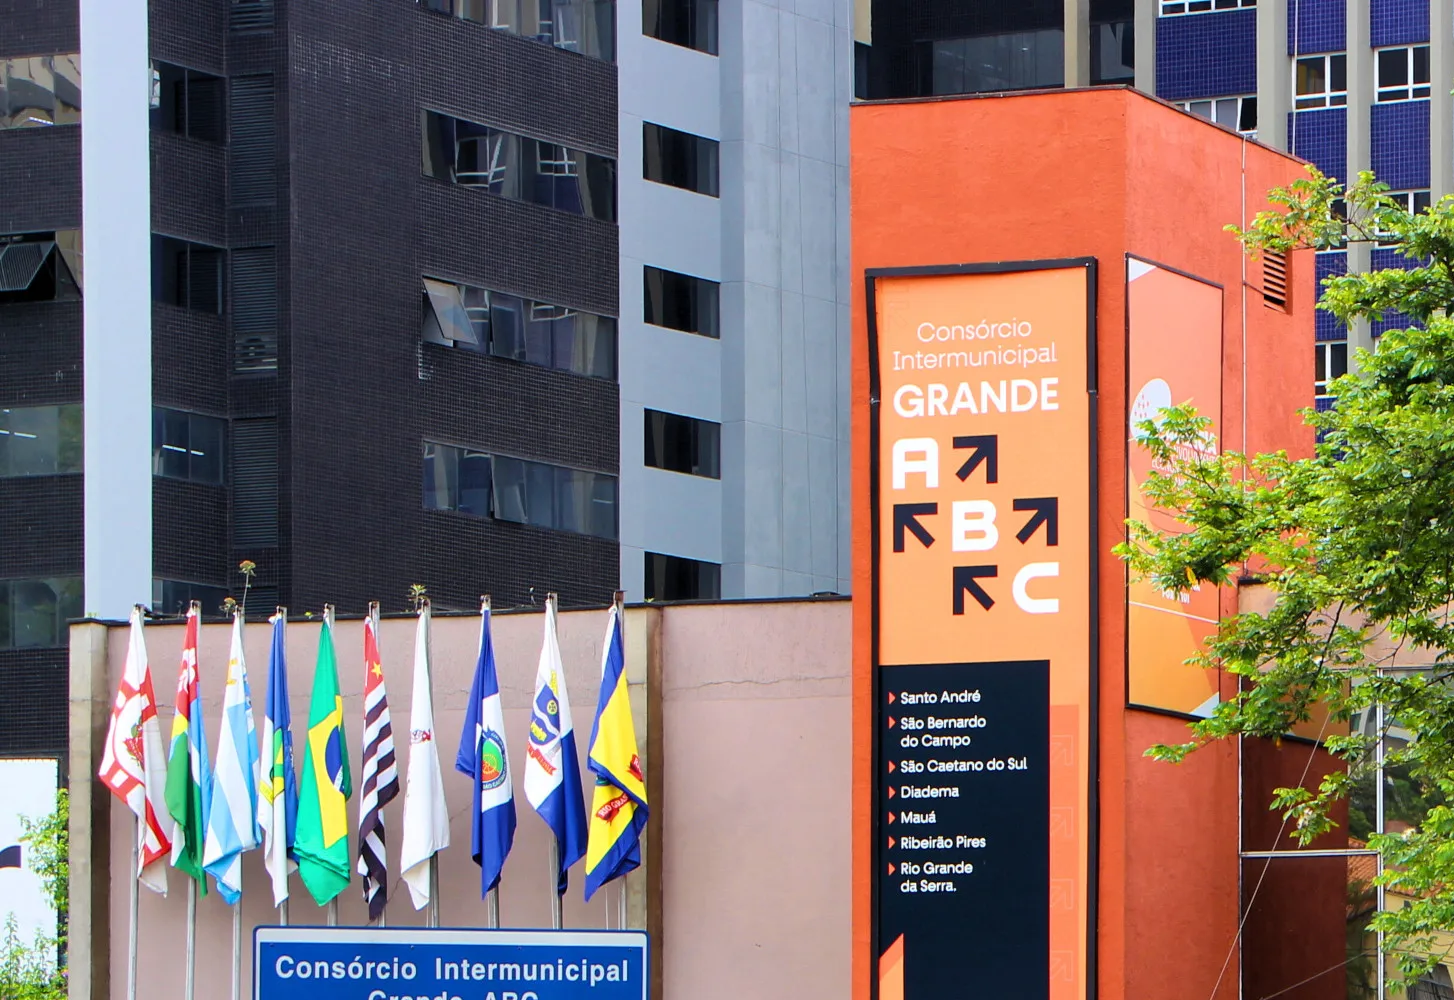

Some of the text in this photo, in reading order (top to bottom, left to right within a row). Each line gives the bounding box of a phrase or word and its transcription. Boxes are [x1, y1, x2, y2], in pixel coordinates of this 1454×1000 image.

[916, 317, 1032, 342] Consórcio
[893, 342, 1058, 371] Intermunicipal
[893, 377, 1060, 419] GRANDE
[892, 437, 939, 490] A
[951, 499, 999, 553] B
[1011, 561, 1060, 615] C
[900, 689, 981, 705] Santo André
[900, 714, 987, 730] São Bernardo
[900, 733, 971, 749] do Campo
[900, 756, 1028, 774] São Caetano do Sul
[900, 784, 960, 799] Diadema
[900, 810, 937, 824] Mauá
[900, 835, 987, 850] Ribeirão Pires
[900, 860, 974, 875] Rio Grande
[900, 879, 957, 893] da Serra.
[275, 955, 628, 987] Consórcio Intermunicipal
